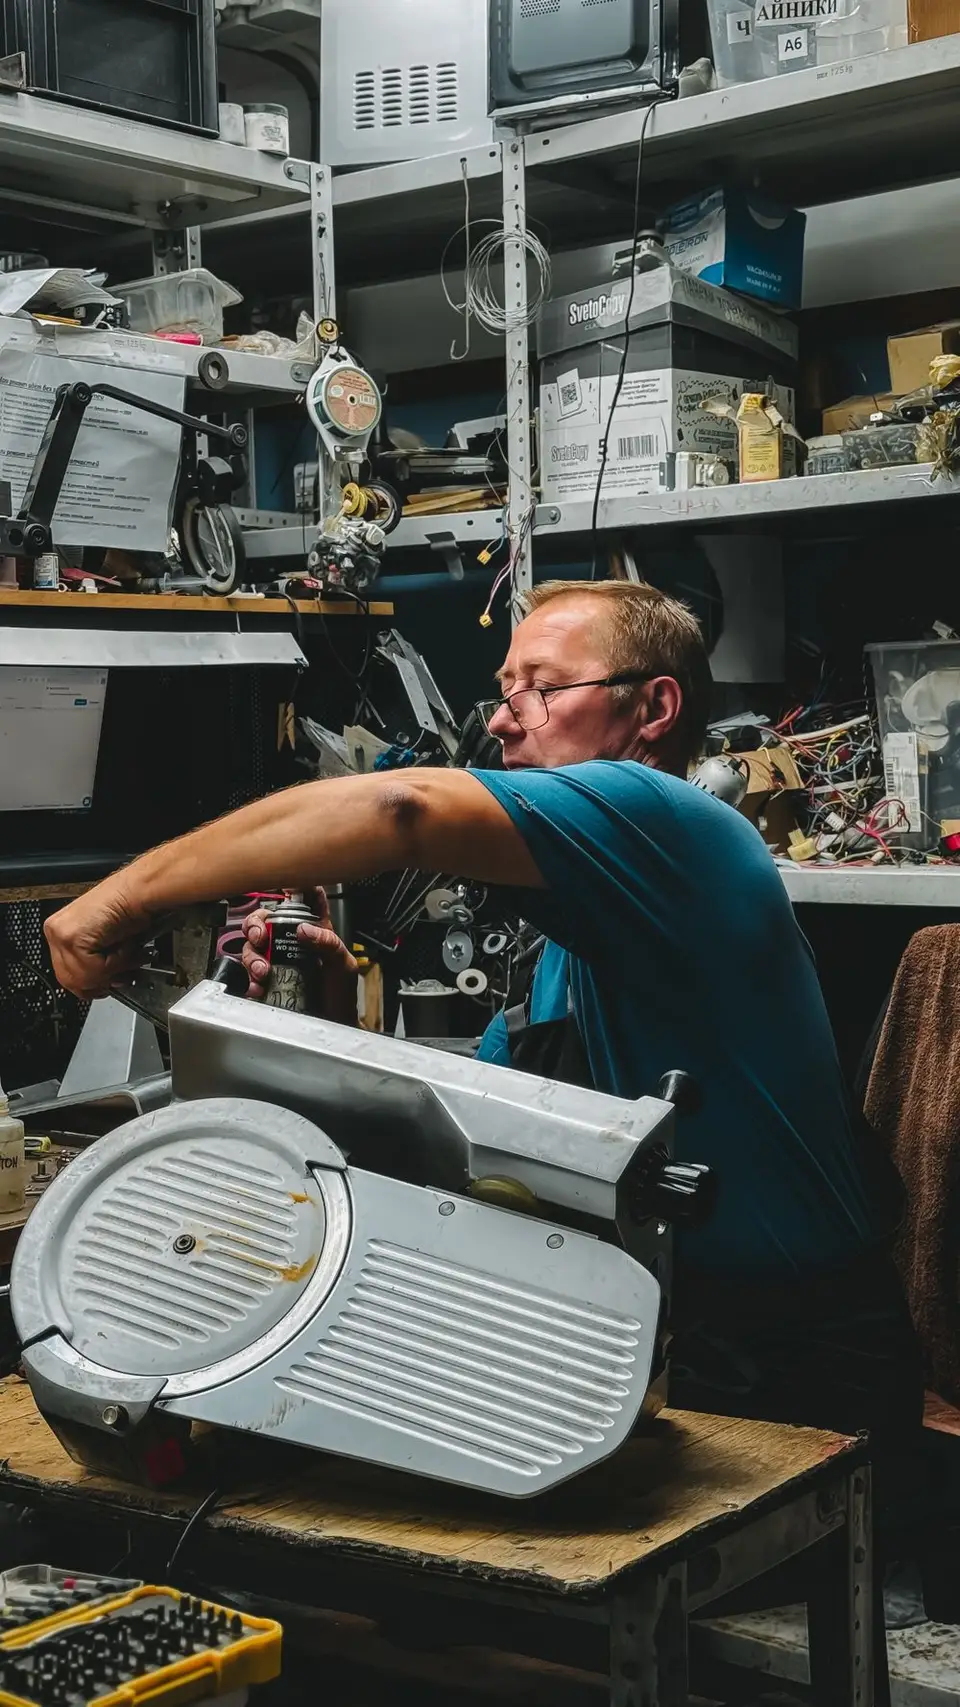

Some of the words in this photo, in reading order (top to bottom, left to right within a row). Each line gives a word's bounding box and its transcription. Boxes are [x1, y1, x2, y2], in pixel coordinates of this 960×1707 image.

[757, 0, 837, 21] АЙНИКИ
[737, 20, 751, 36] Ч
[568, 293, 625, 327] SvetoCopy
